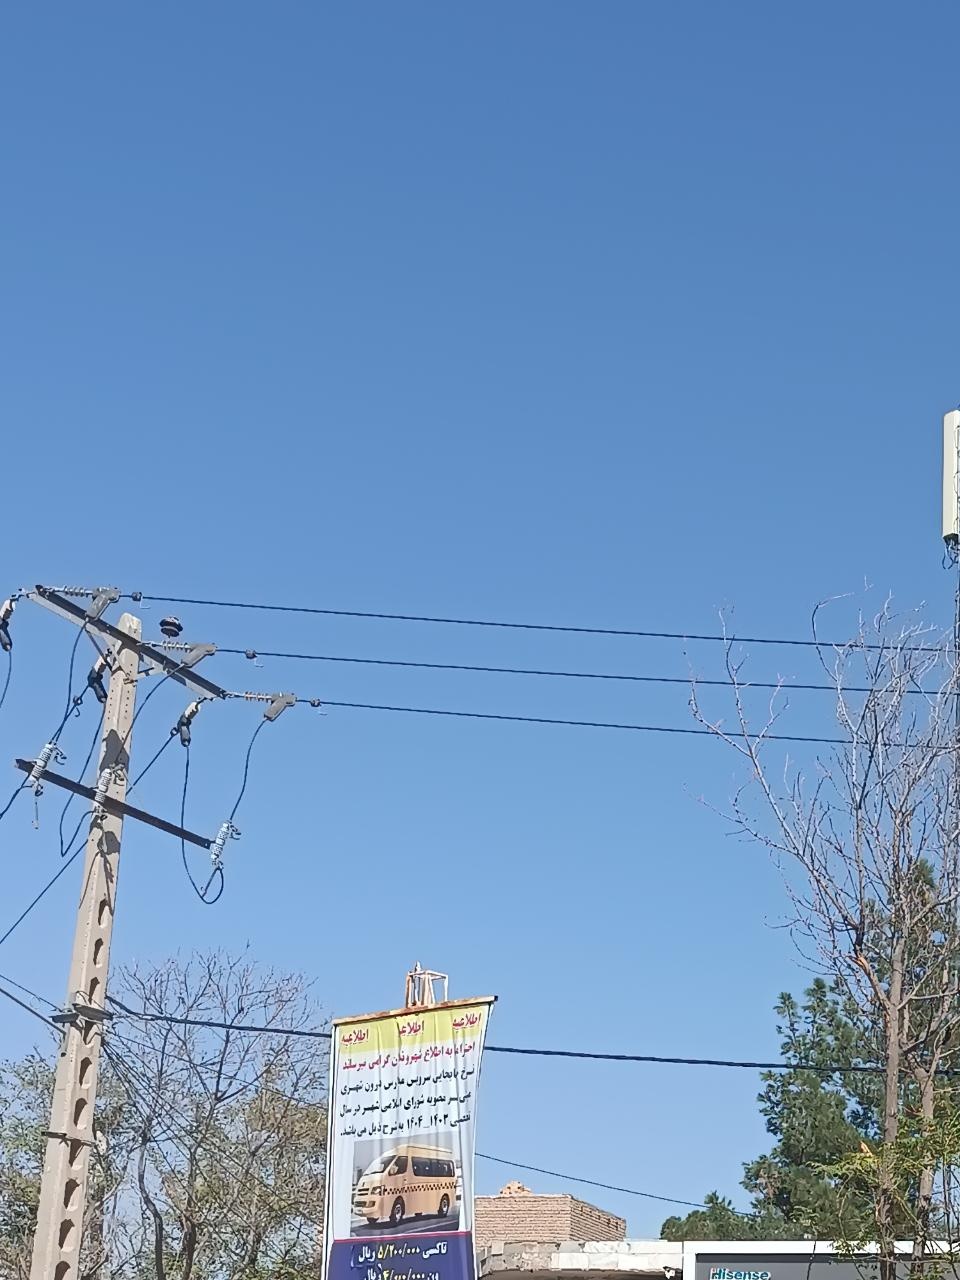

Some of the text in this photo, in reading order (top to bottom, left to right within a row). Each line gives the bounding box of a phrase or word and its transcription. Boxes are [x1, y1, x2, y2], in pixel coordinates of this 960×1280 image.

[423, 1046, 445, 1062] اطلاع
[358, 1245, 376, 1262] ریال
[422, 1241, 448, 1259] تاکسی
[710, 1268, 771, 1280] Hisense
